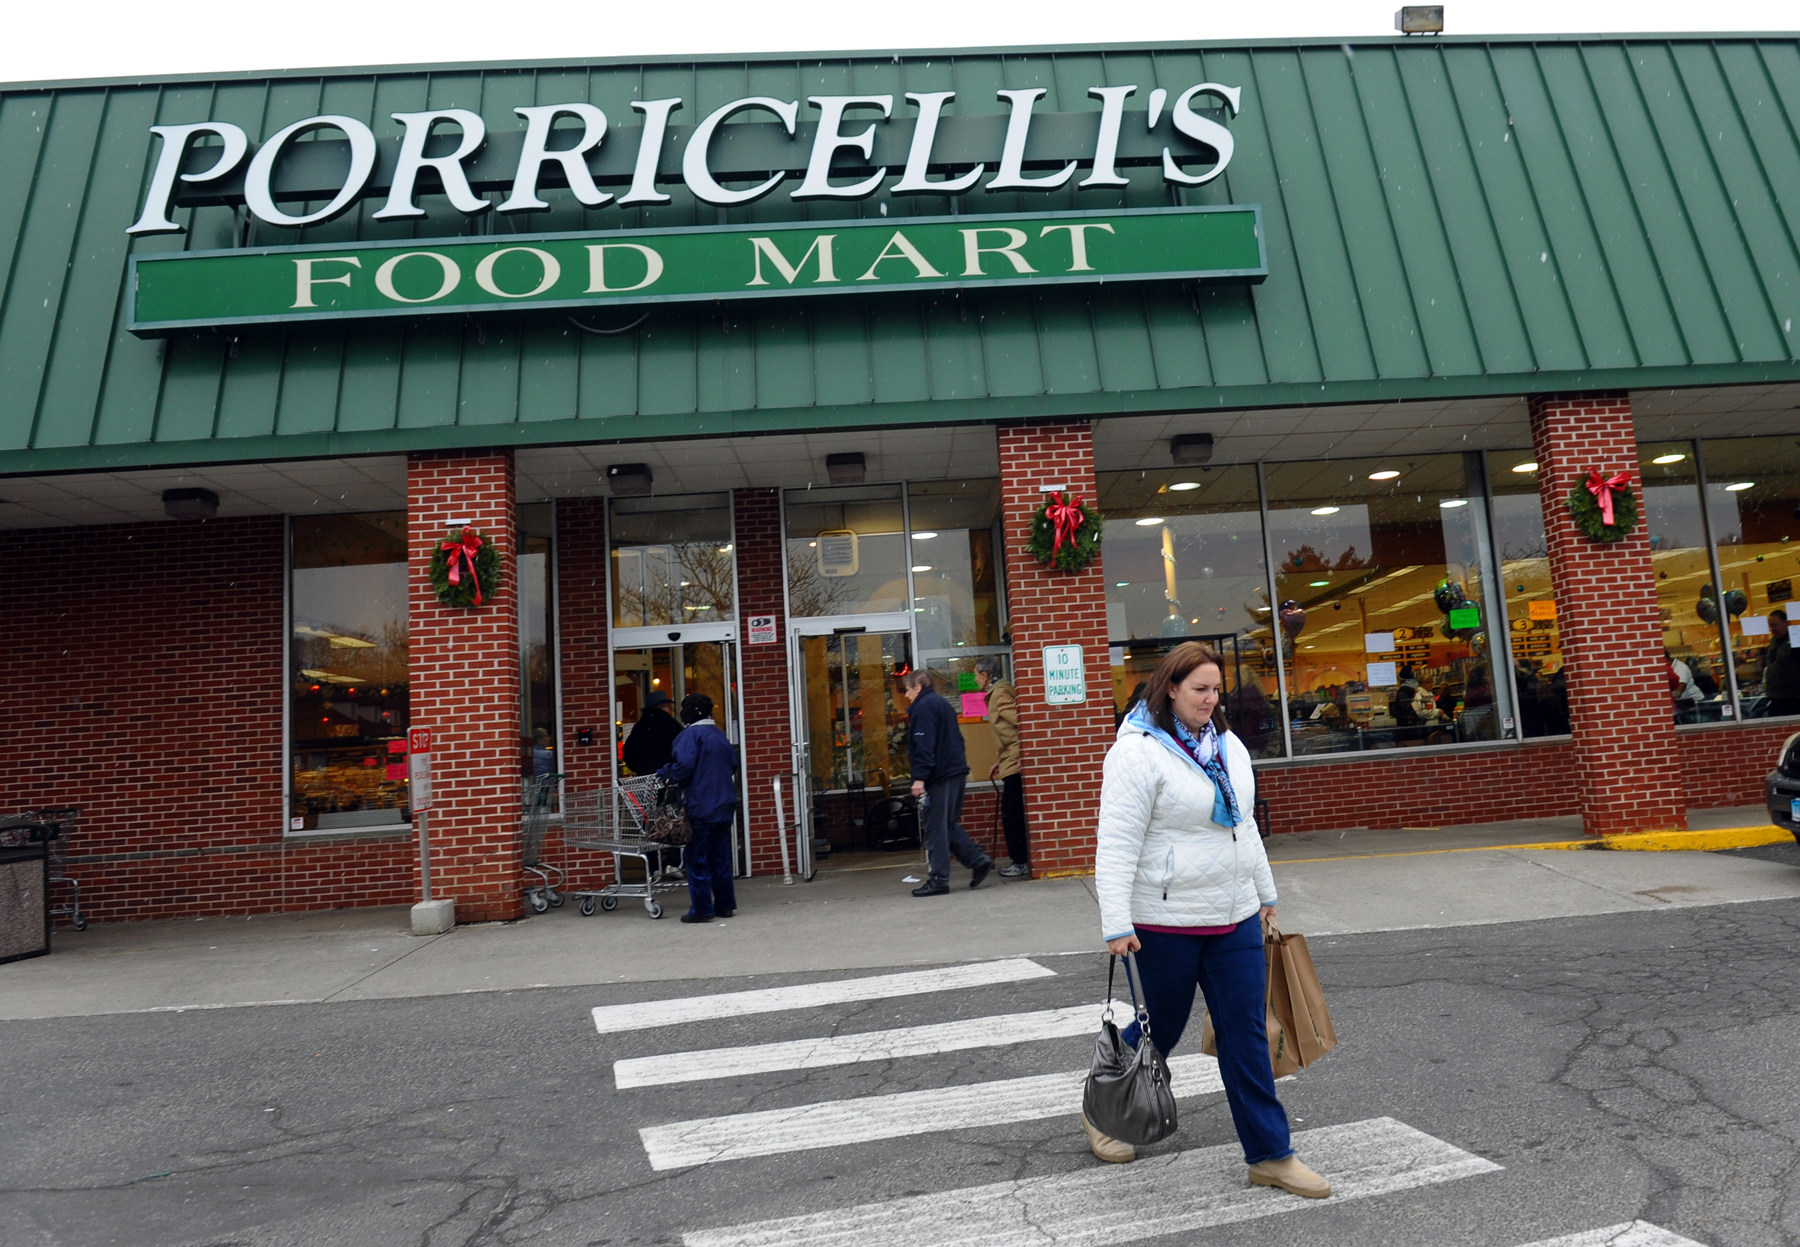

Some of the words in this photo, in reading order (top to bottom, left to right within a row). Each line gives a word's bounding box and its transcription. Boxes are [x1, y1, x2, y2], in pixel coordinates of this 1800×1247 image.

[125, 82, 1242, 235] PORRICELLI'S
[289, 243, 664, 308] FOOD
[746, 223, 1115, 286] MART
[1398, 629, 1407, 639] 2
[1057, 653, 1069, 665] 10
[1049, 668, 1080, 680] MINUTE
[1049, 684, 1082, 696] PARKING
